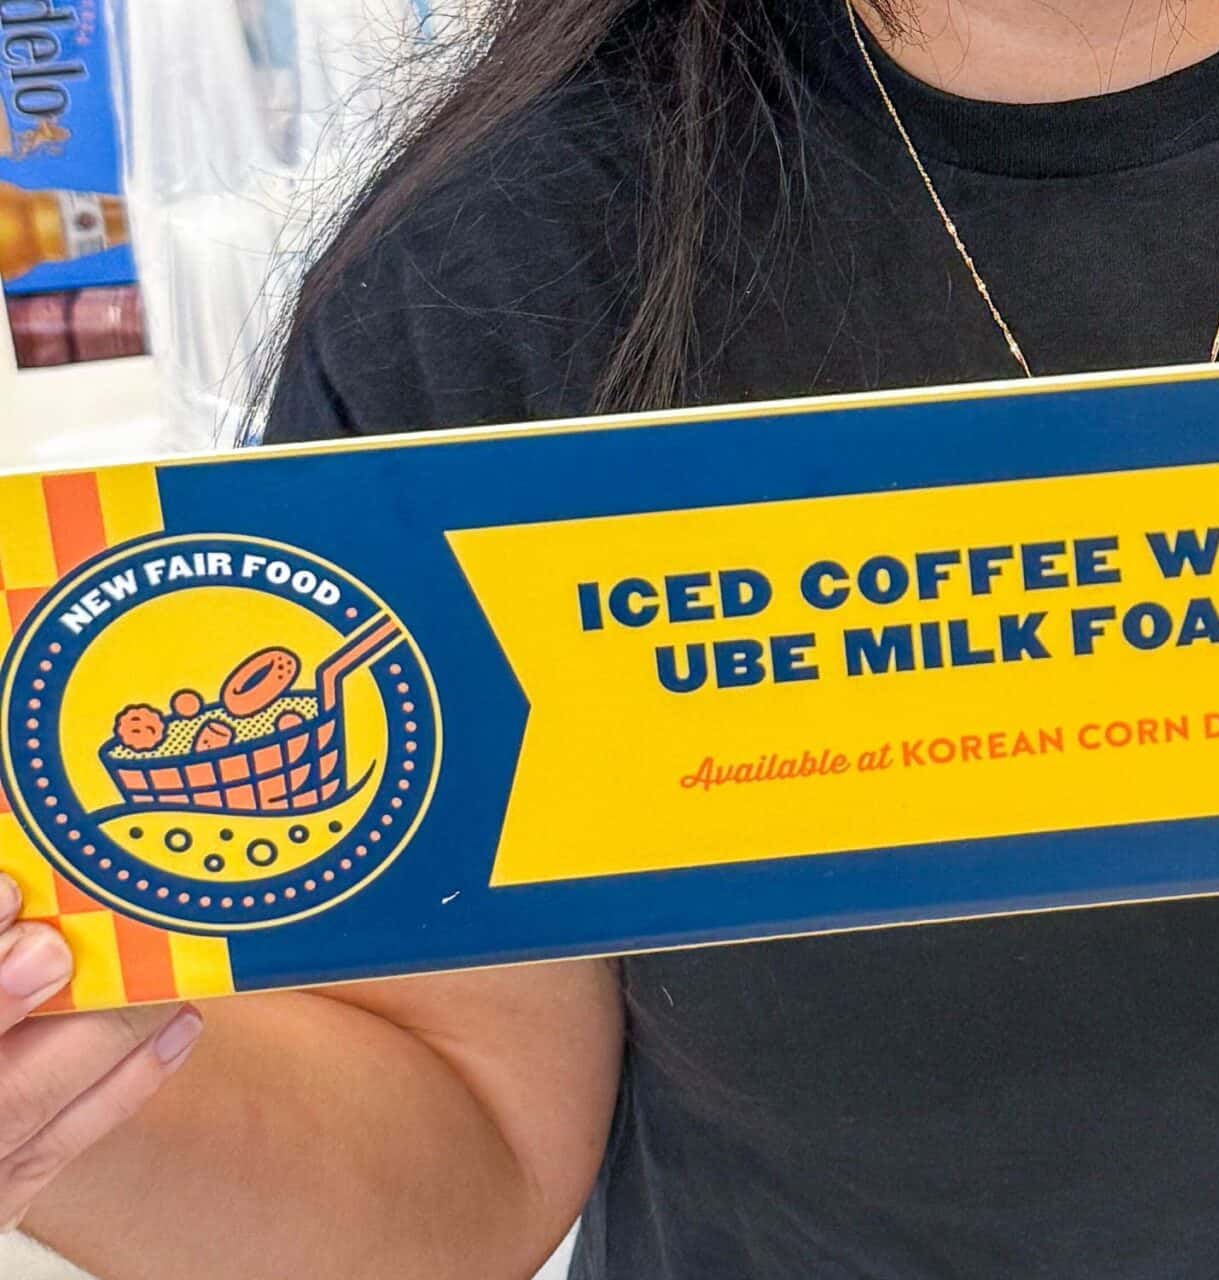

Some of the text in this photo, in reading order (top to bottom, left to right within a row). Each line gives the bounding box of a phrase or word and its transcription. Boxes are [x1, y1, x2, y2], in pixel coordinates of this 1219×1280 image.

[59, 552, 341, 634] NEW FAIR FOOD
[577, 569, 772, 632] ICED
[800, 536, 1121, 610] COFFEE
[655, 633, 819, 693] UBE
[844, 611, 1052, 676] MILK
[680, 749, 850, 791] Available
[858, 742, 893, 772] at
[902, 727, 1064, 767] KOREAN
[1078, 715, 1190, 750] CORN
